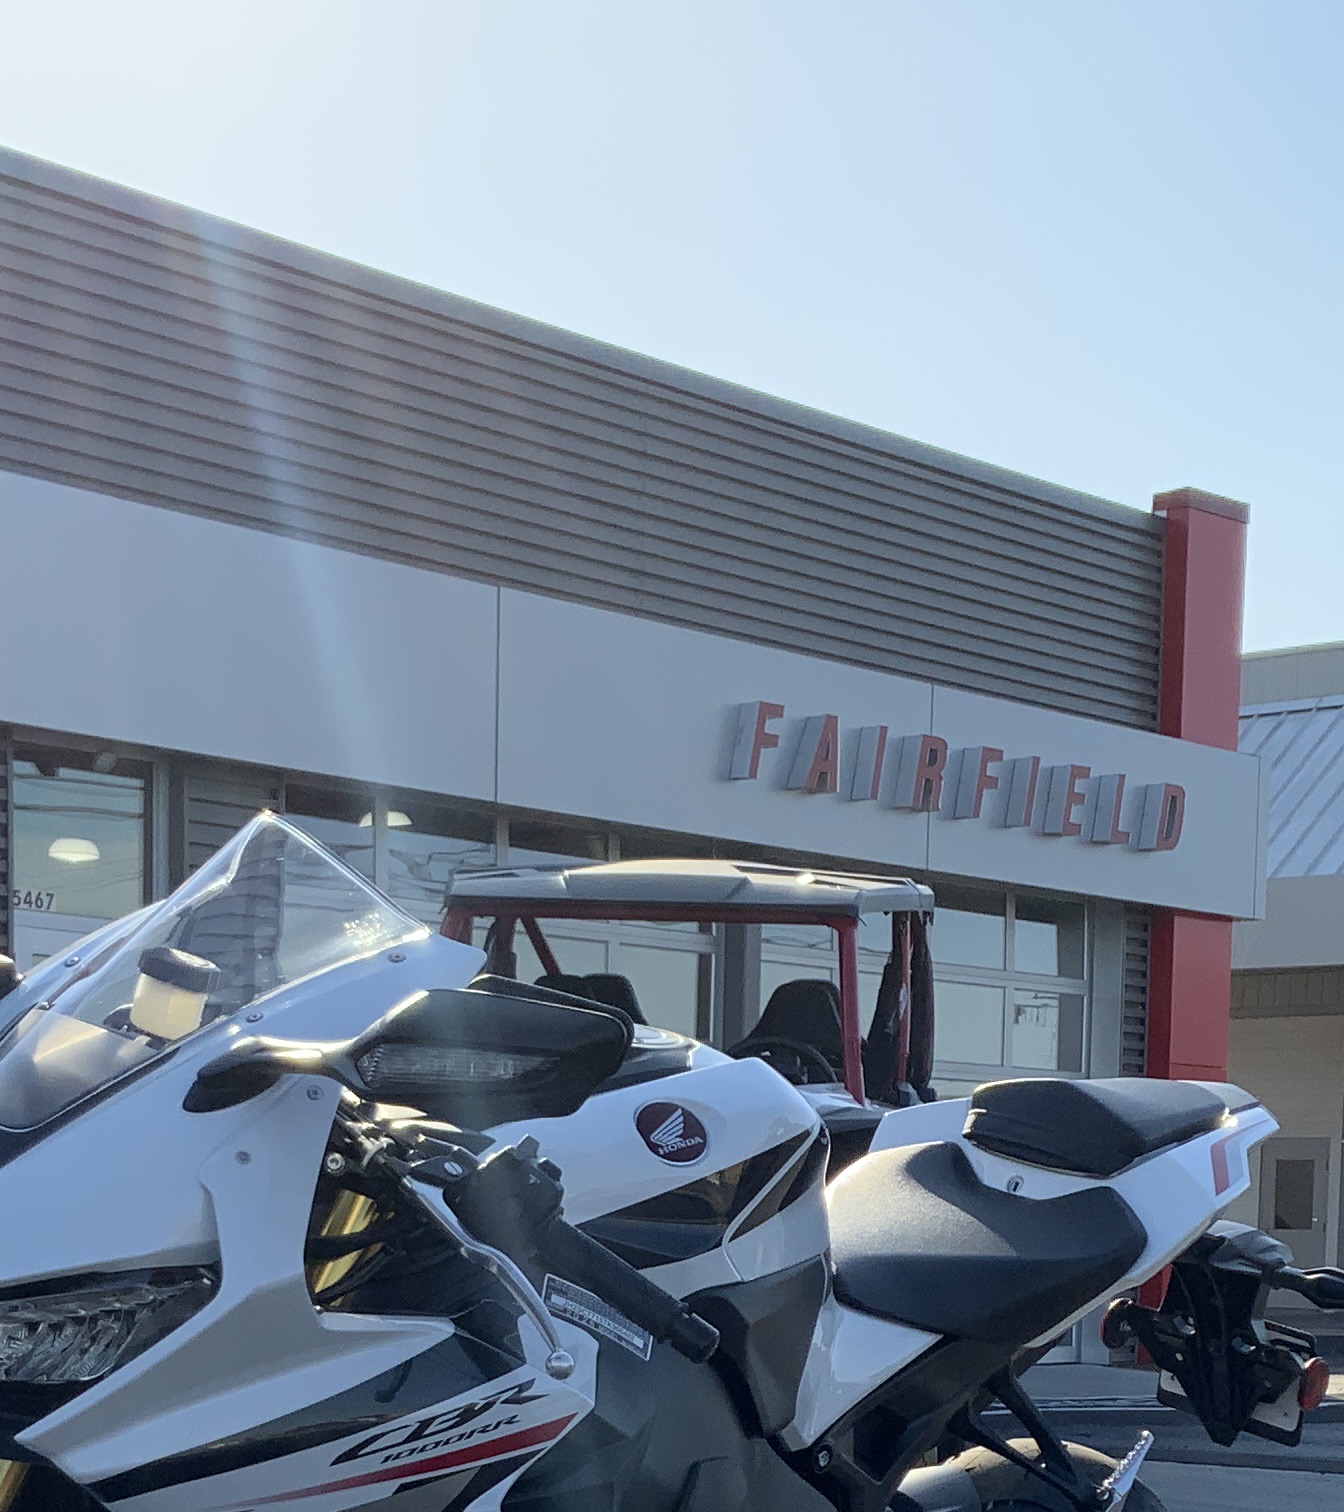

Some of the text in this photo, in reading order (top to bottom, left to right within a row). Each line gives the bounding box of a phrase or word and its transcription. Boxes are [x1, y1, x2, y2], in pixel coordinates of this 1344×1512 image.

[734, 700, 1187, 851] FAIRFIELD
[12, 889, 55, 910] 5467
[658, 1136, 704, 1155] HONDA
[330, 1378, 550, 1467] CBR
[380, 1414, 521, 1464] 1000RR
